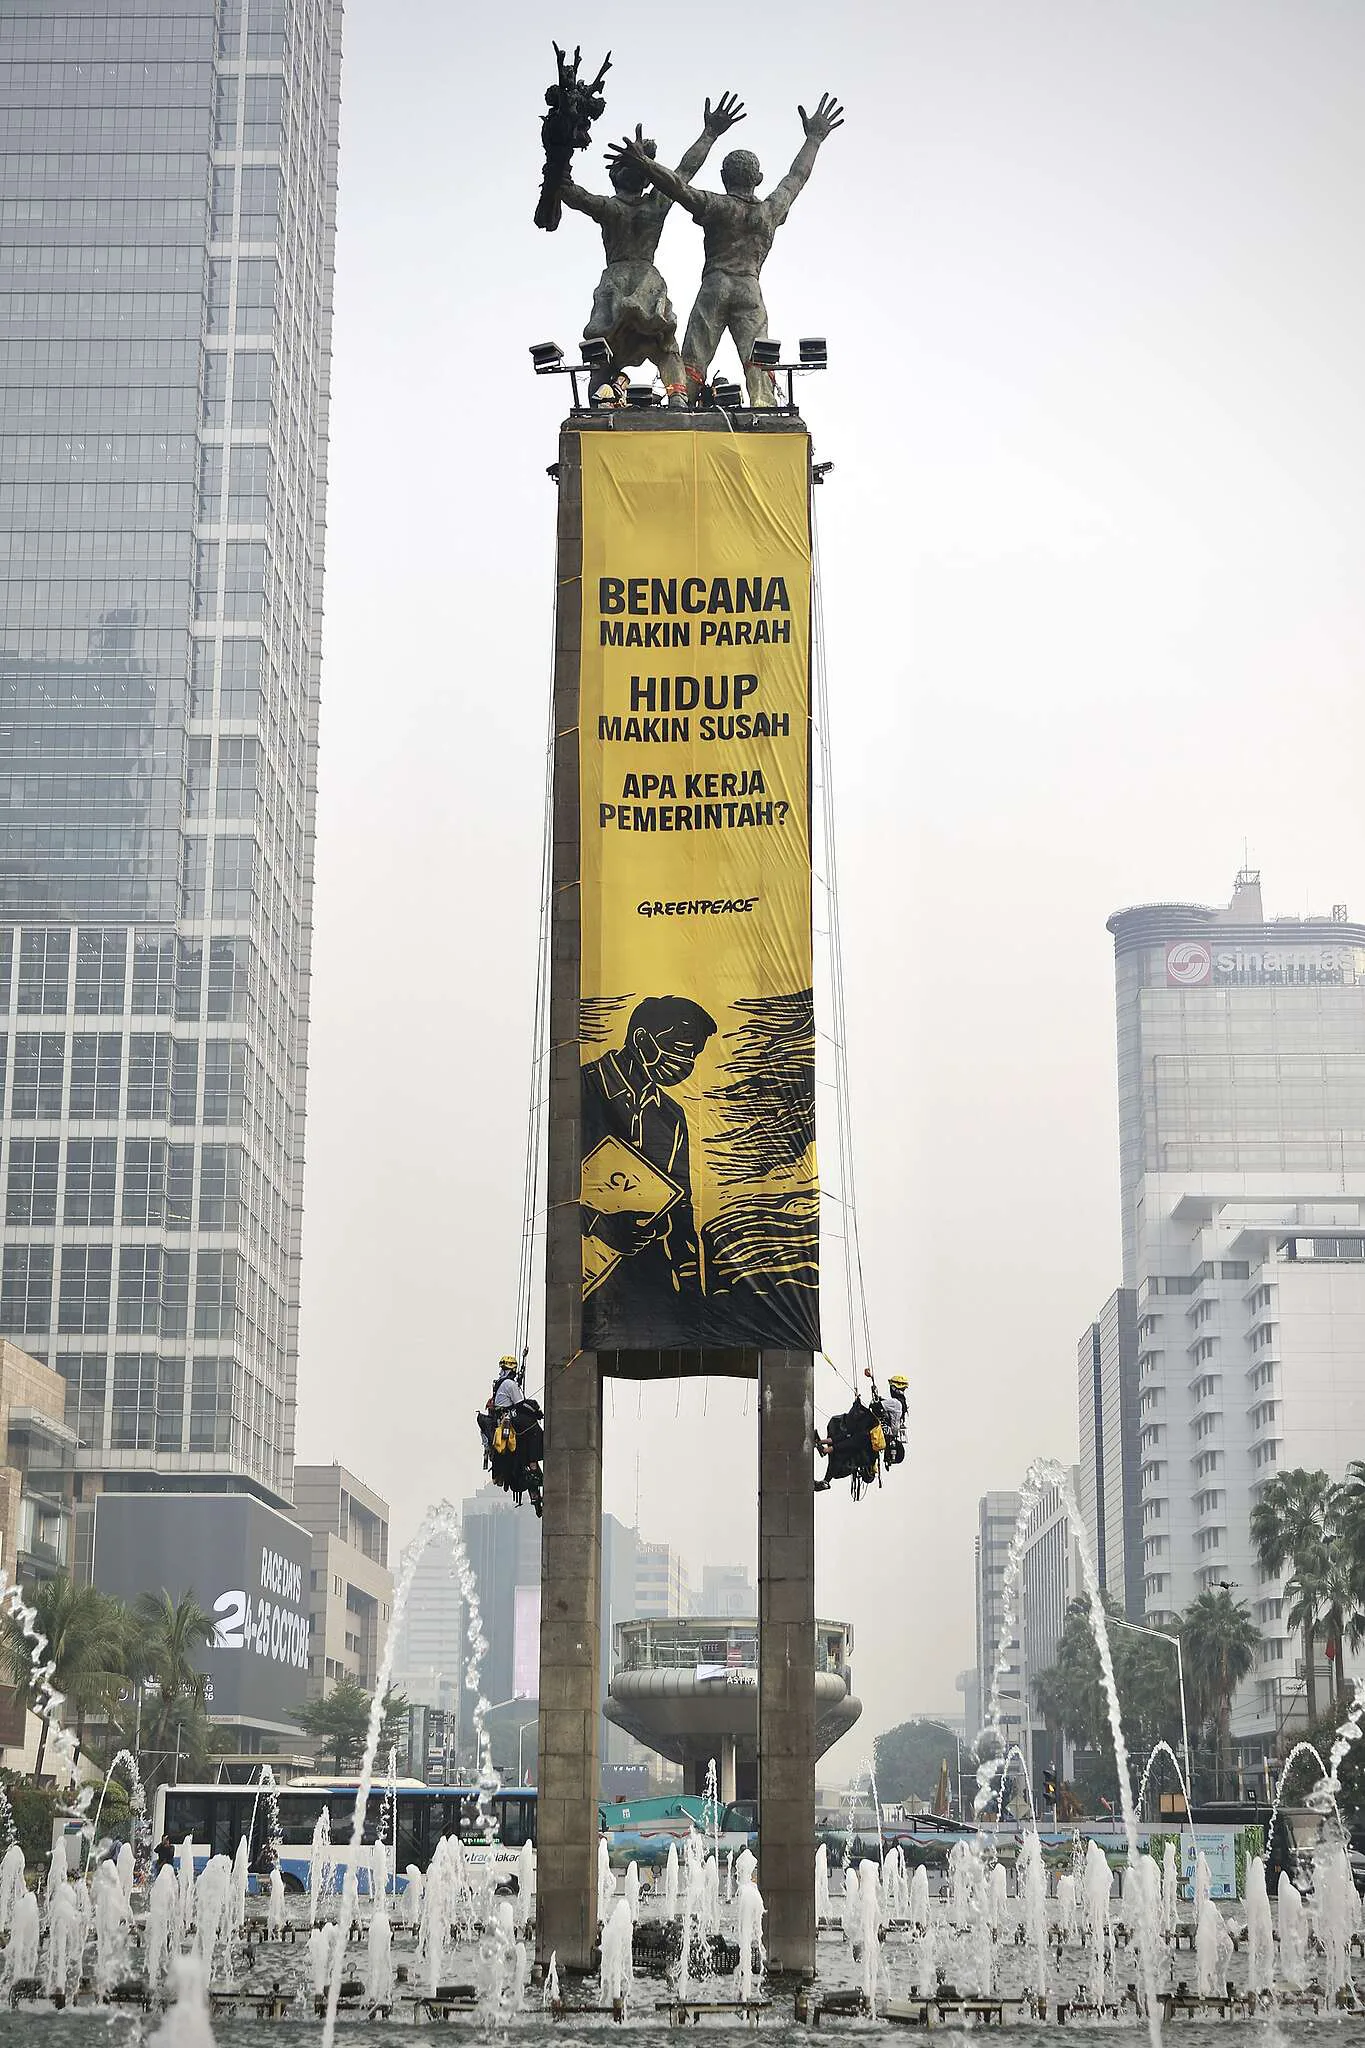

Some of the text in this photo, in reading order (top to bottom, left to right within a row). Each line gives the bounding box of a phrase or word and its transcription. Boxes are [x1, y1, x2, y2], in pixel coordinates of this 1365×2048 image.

[599, 576, 791, 616] BENCANA
[600, 619, 791, 648] MAKIN PARAH
[630, 674, 759, 712] HIDUP
[598, 712, 790, 743] MAKIN SUSAH
[622, 769, 766, 799] APA KERJA
[600, 801, 790, 832] PEMERINTAH?
[637, 897, 760, 918] GREENPEACE
[610, 1171, 637, 1192] CV
[260, 1546, 302, 1604] RACE DAYS
[206, 1590, 271, 1657] 24-25
[726, 1676, 758, 1686] ASTRA
